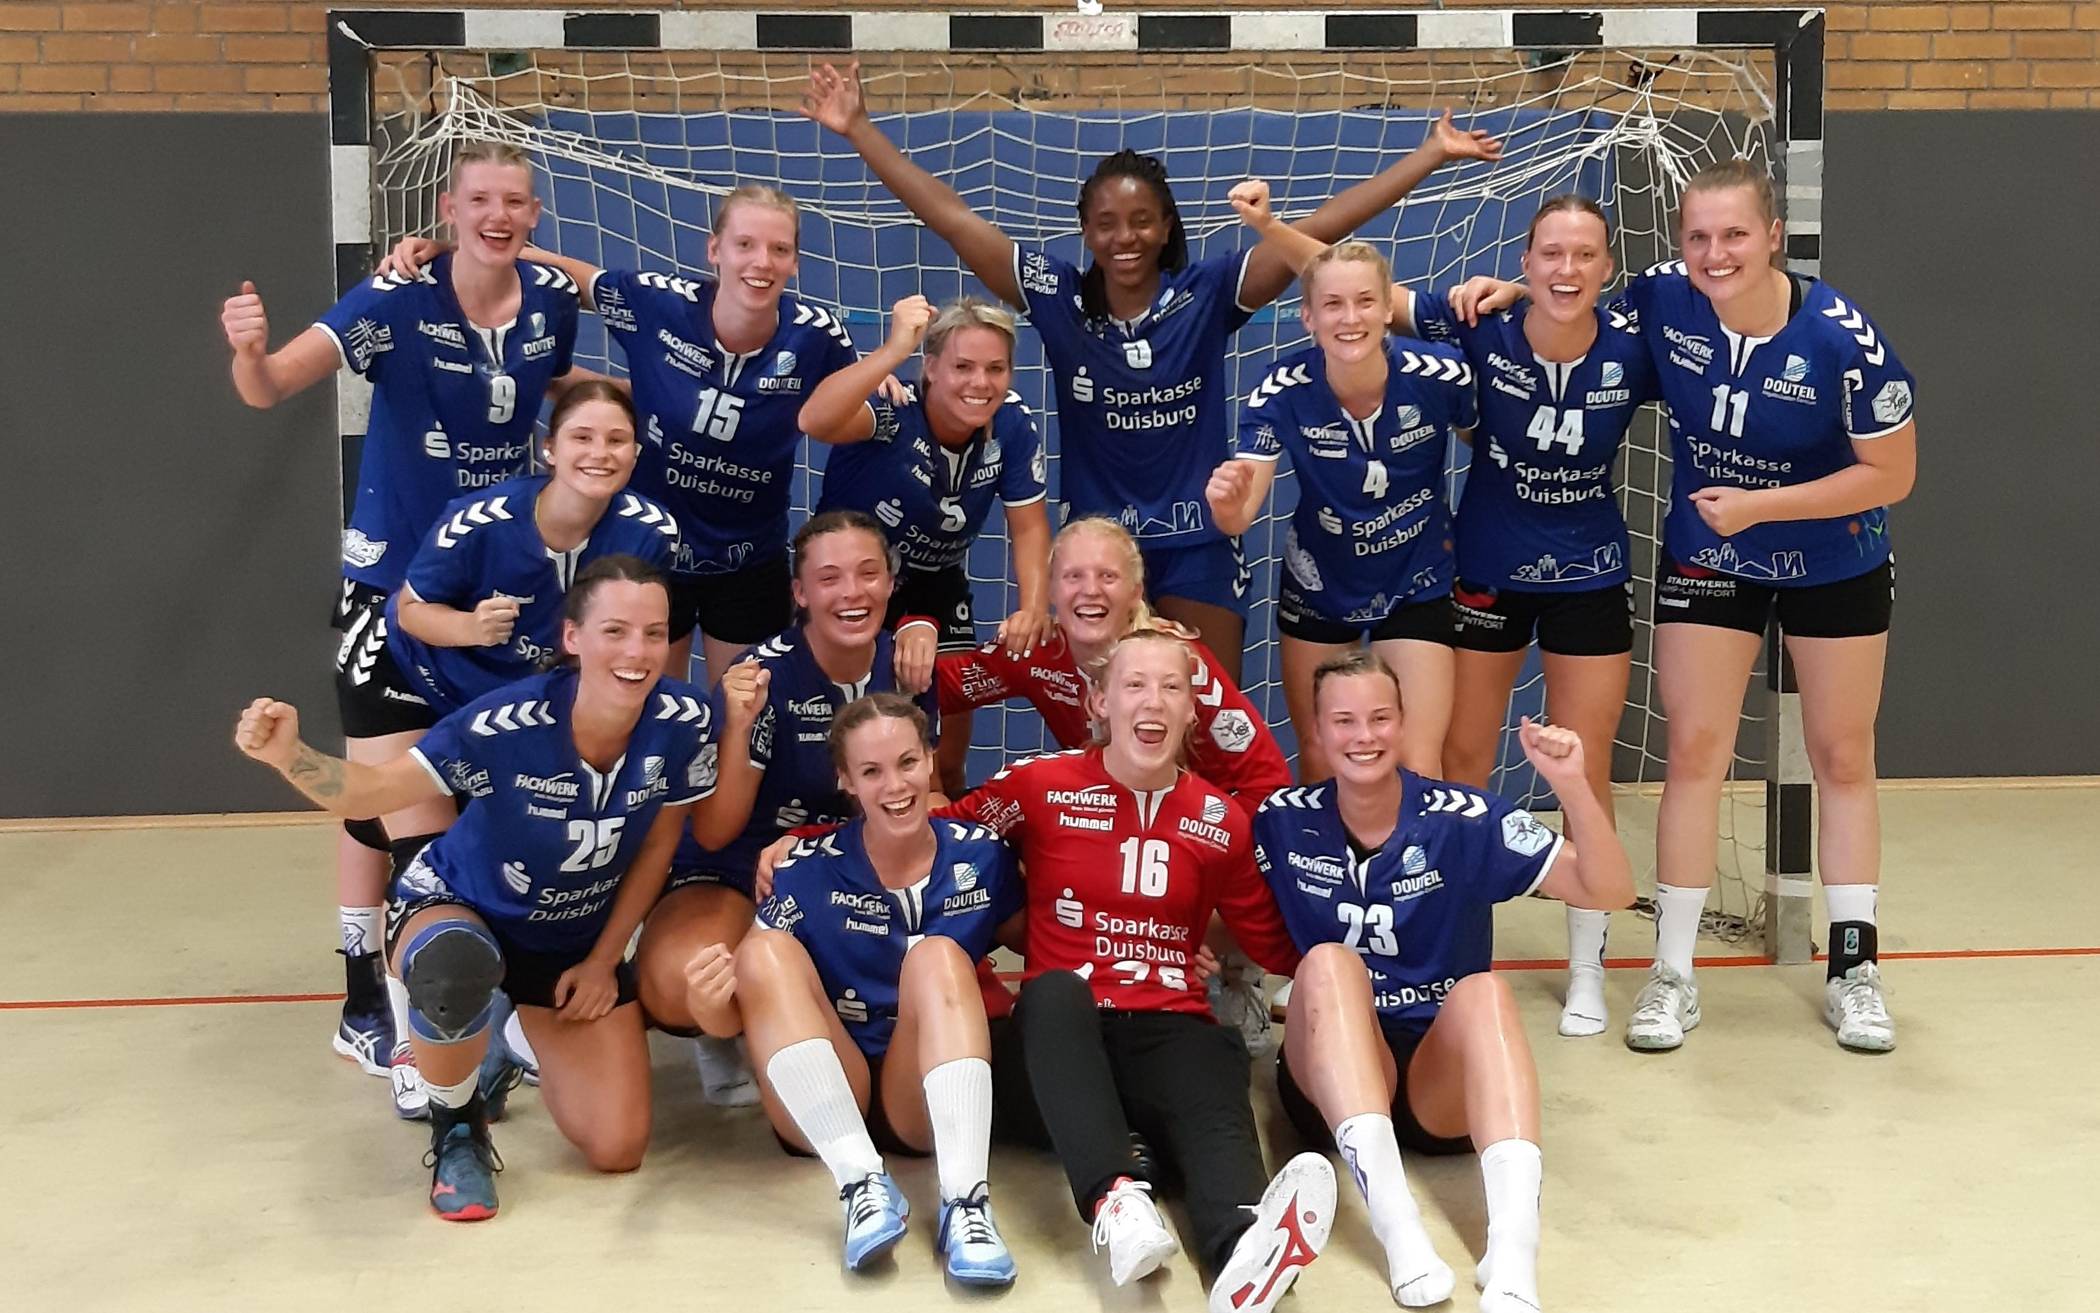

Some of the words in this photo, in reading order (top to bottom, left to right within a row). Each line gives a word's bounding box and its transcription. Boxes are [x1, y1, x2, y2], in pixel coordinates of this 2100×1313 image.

[657, 328, 715, 370] FACHWERK
[488, 375, 516, 424] 9
[1103, 376, 1202, 406] Sparkasse
[1763, 377, 1817, 401] DOUTEIL
[692, 386, 745, 442] 15
[1106, 404, 1196, 431] Duisburg
[1711, 383, 1750, 438] 11
[1526, 405, 1585, 455] 44
[668, 442, 773, 484] Sparkasse
[1362, 460, 1390, 499] 4
[665, 467, 755, 504] Duisburg
[940, 497, 967, 532] 5
[1352, 488, 1434, 539] Sparkasse
[515, 774, 579, 797] FACHWERK
[1046, 790, 1118, 807] FACHWERK
[1059, 812, 1113, 831] hummel
[1178, 818, 1232, 848] DOUTEIL
[559, 816, 626, 873] 25
[1119, 836, 1169, 898] 16
[1288, 851, 1346, 879] FACHWERK
[537, 874, 623, 905] Sparkas
[944, 888, 991, 910] DOUTEIL
[1392, 869, 1443, 896] DOUTEIL
[846, 917, 889, 936] hummel
[1095, 911, 1189, 942] Sparkasse
[1337, 902, 1399, 956] 23
